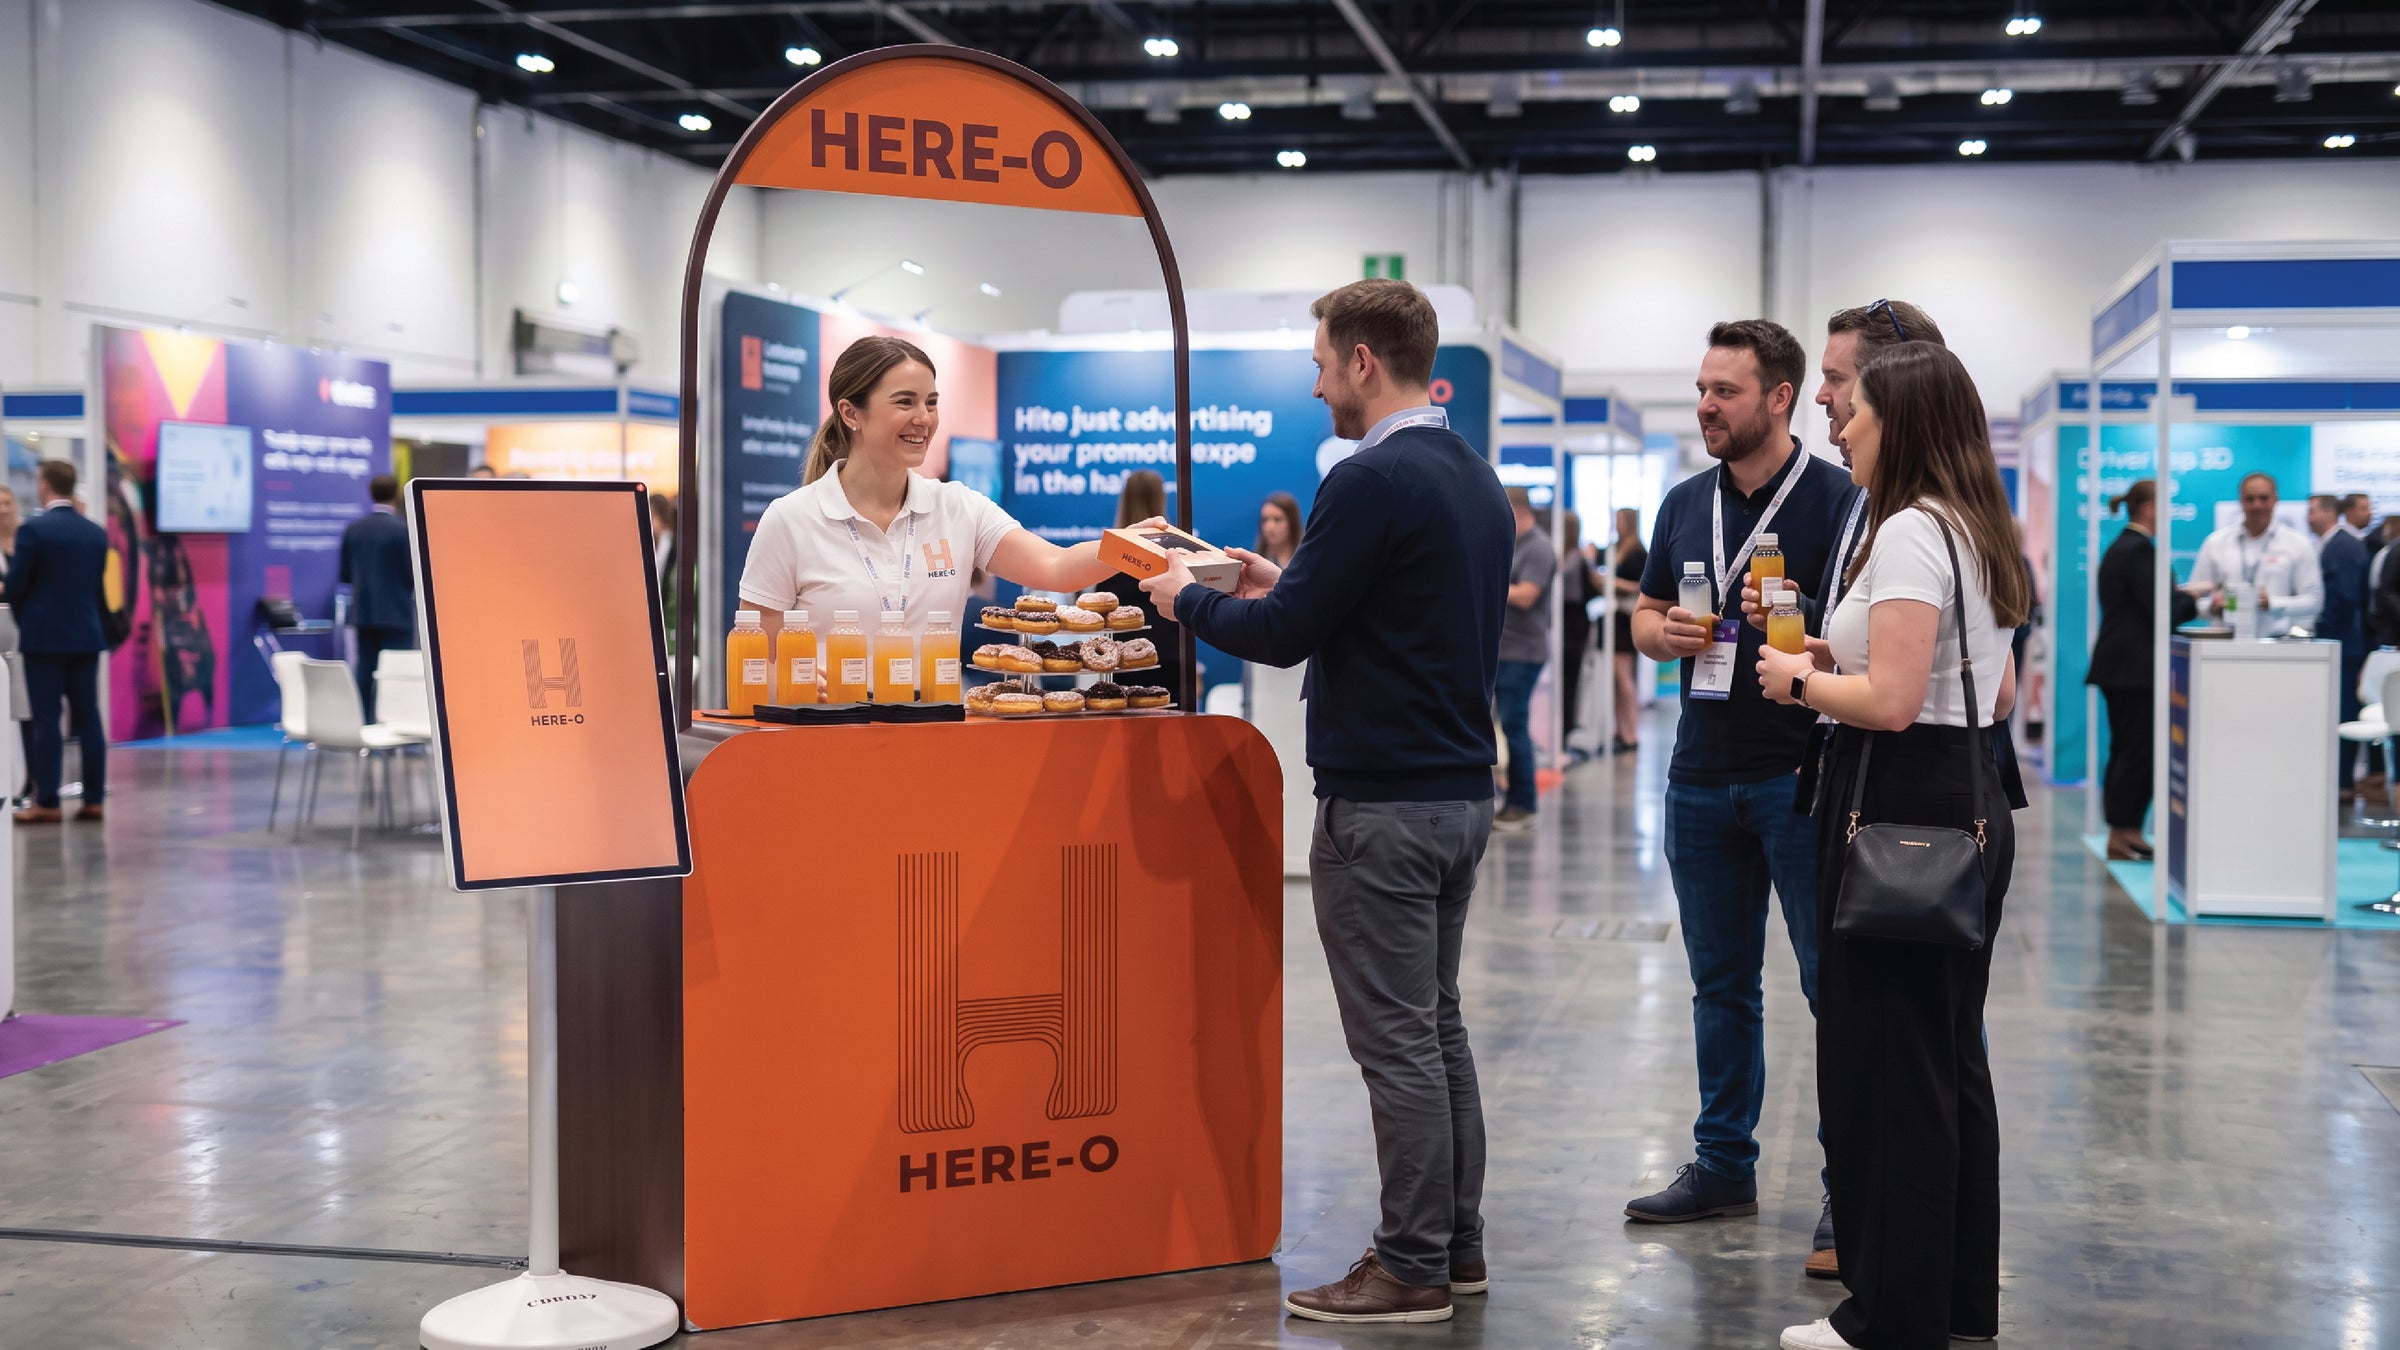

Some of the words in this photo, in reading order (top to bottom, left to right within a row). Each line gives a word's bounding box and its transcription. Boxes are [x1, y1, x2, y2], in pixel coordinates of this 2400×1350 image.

[811, 108, 1083, 189] HERE-O
[1069, 405, 1122, 438] just
[1124, 404, 1273, 438] advrtising
[1014, 443, 1073, 468] your
[1014, 467, 1040, 495] in
[1042, 469, 1087, 495] the
[928, 569, 956, 578] HERE-O
[521, 637, 582, 709] H
[531, 714, 585, 726] HERE-O
[898, 843, 1118, 1134] H
[899, 1134, 1120, 1193] HERE-O
